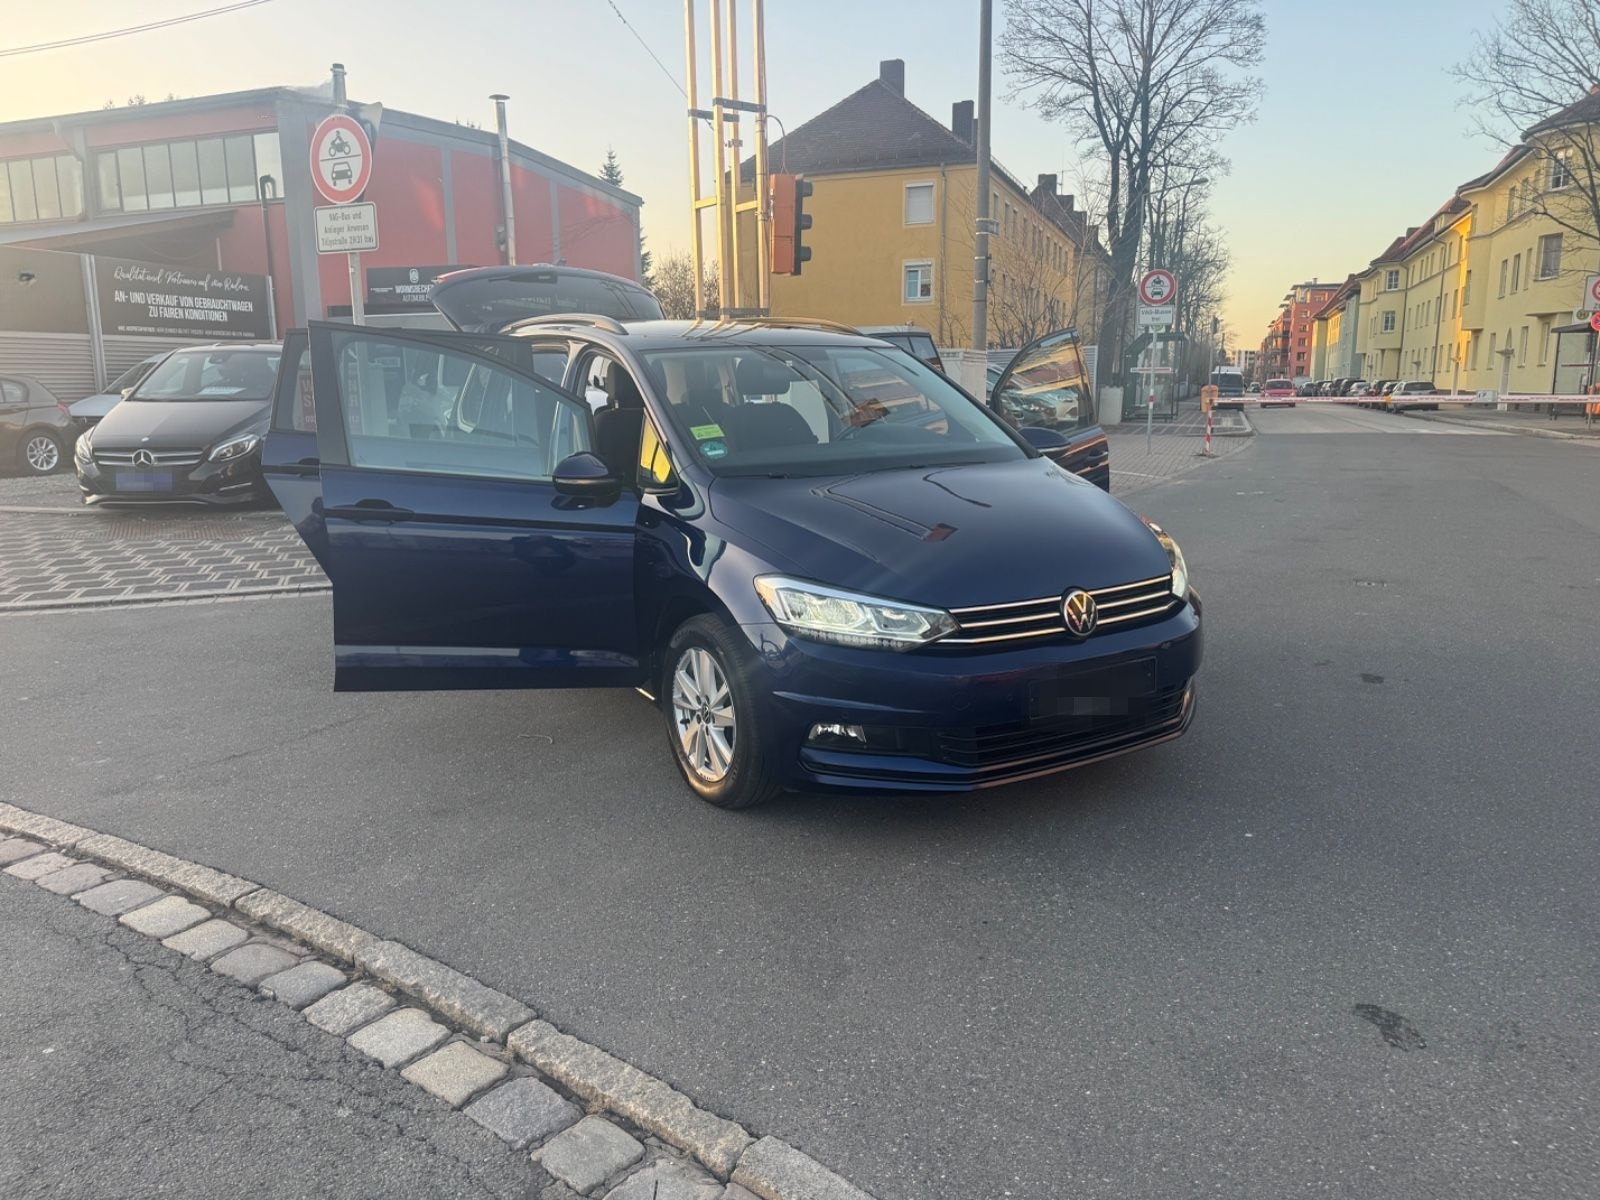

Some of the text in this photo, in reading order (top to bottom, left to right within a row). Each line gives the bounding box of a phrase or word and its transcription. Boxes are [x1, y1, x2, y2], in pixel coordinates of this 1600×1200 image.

[114, 290, 253, 312] AN- UND VERKAUF VON GEBRAUCHTWAGEN
[148, 305, 228, 322] ZU FAIREN KONDITIONEN
